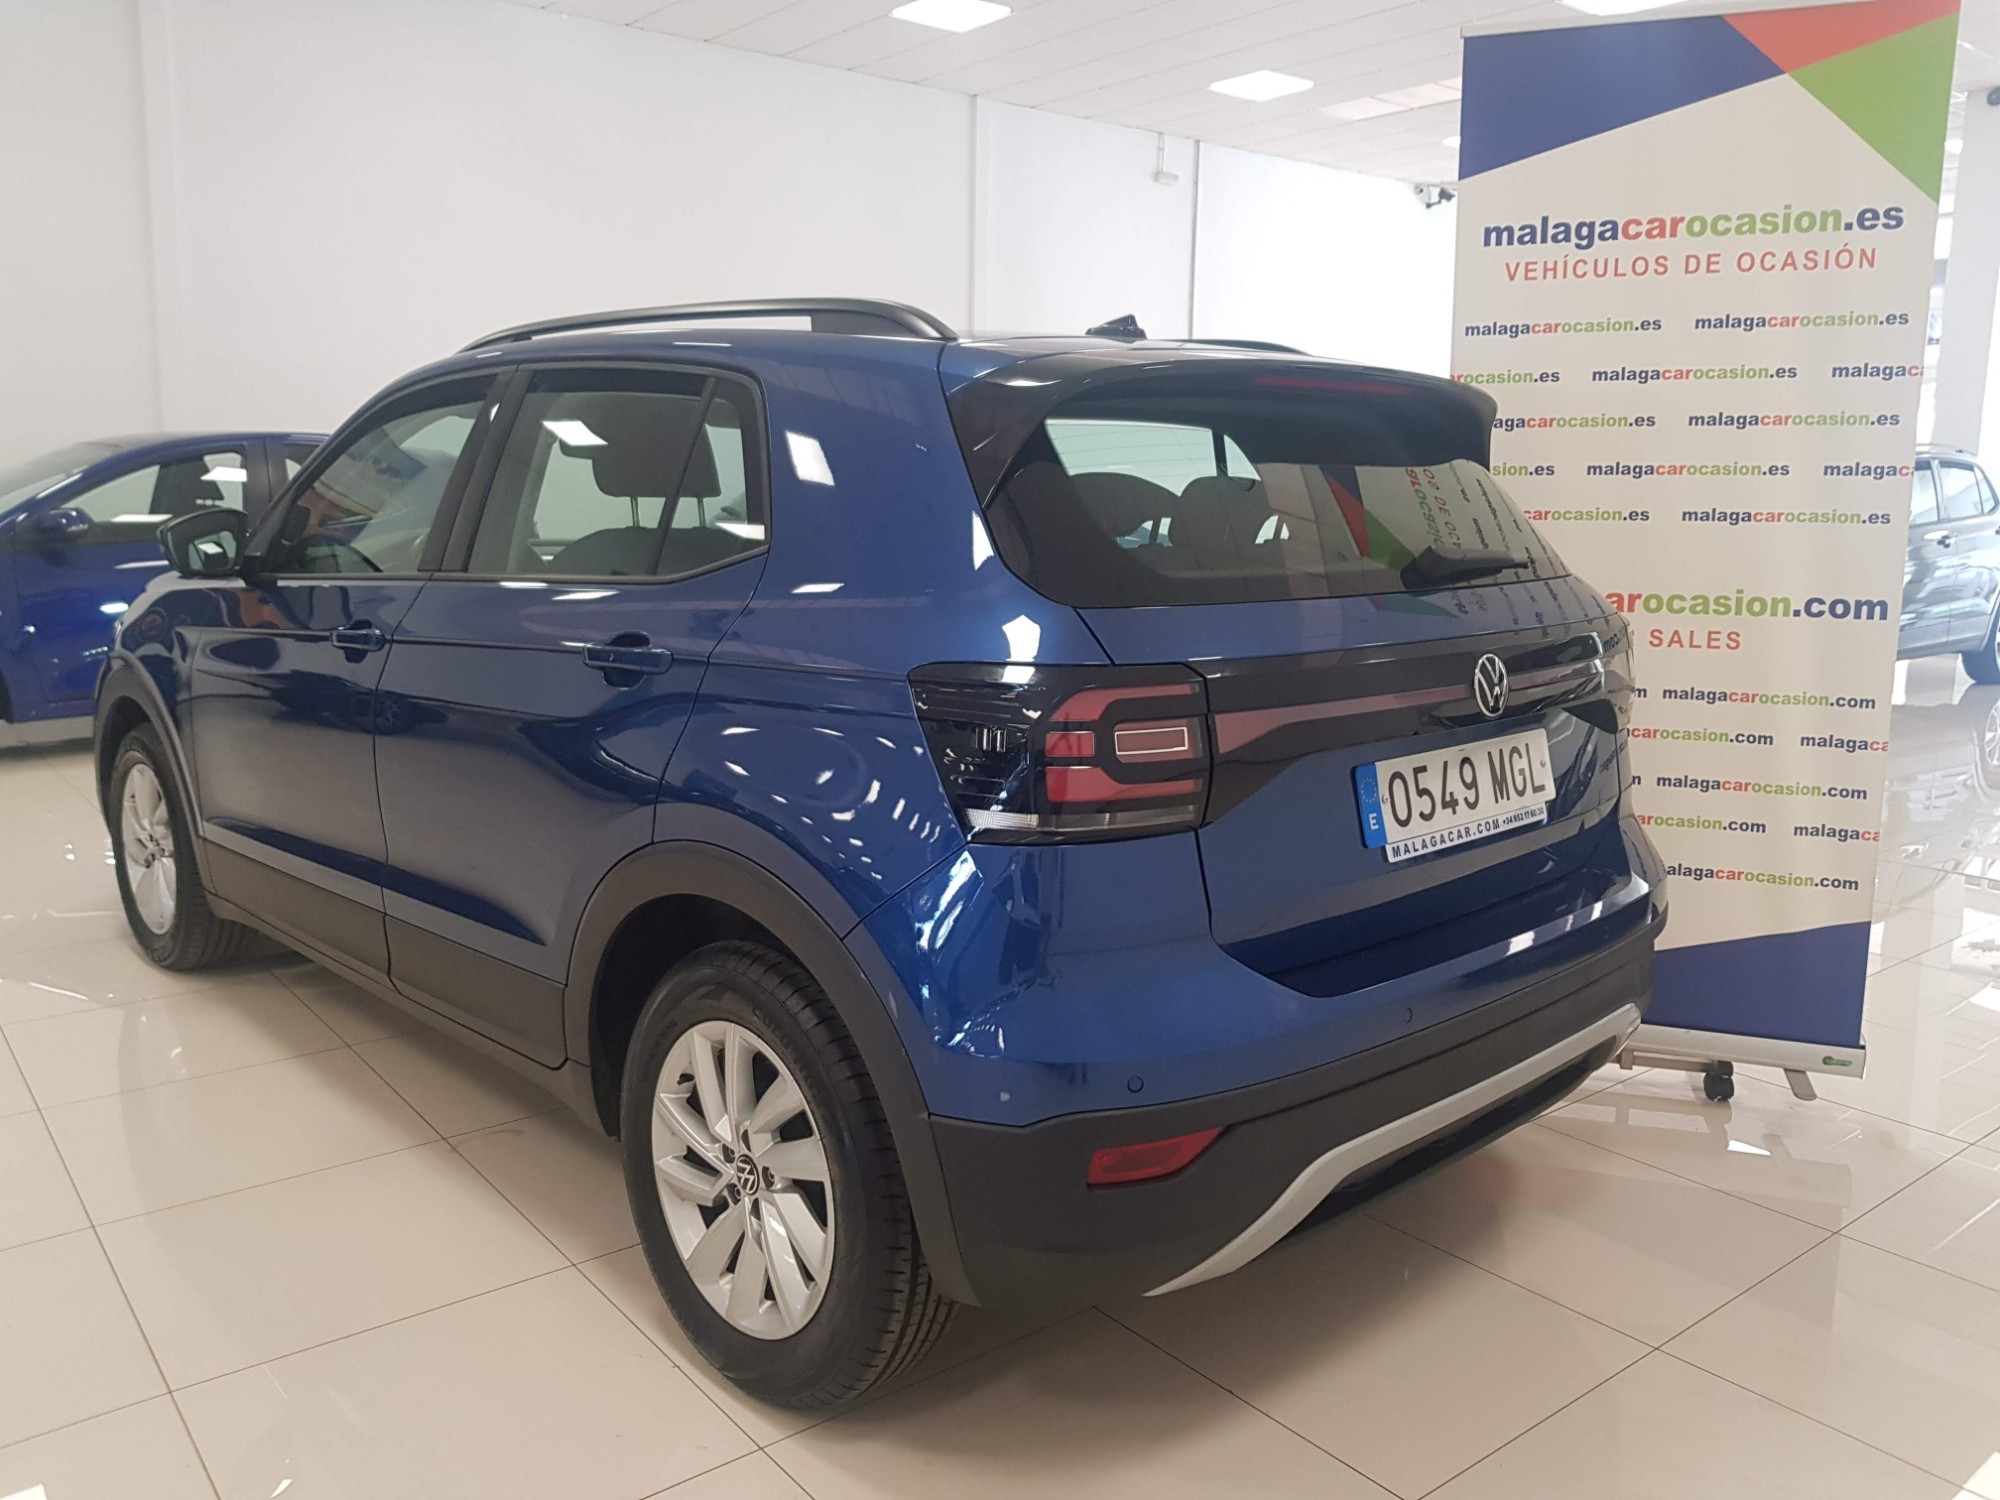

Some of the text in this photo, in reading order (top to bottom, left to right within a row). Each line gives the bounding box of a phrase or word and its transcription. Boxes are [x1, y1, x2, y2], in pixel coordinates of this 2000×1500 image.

[1483, 204, 1904, 250] malagacarocasion.es
[1505, 243, 1877, 281] VEHÍCULOS DE OCASIÓN
[1464, 310, 1909, 338] malagacarocasion.es malagacarocasion.es
[1592, 364, 1797, 385] malagacarocasion.es
[1832, 362, 1924, 382] malagac
[1688, 411, 1900, 430] malagacarocasion.es
[1586, 461, 1789, 480] malagacarocasion.es
[1823, 461, 1914, 480] malagac
[1682, 507, 1890, 526] malagacarocasion.es
[1649, 629, 1741, 650] SALES
[1662, 686, 1876, 710] malagacarocasion.com
[1388, 756, 1480, 828] 0549
[1487, 743, 1546, 804] MGL
[1656, 774, 1867, 801] malagacarocasion.com
[1369, 813, 1379, 831] E
[1391, 818, 1500, 859] MALAGACAR.COM
